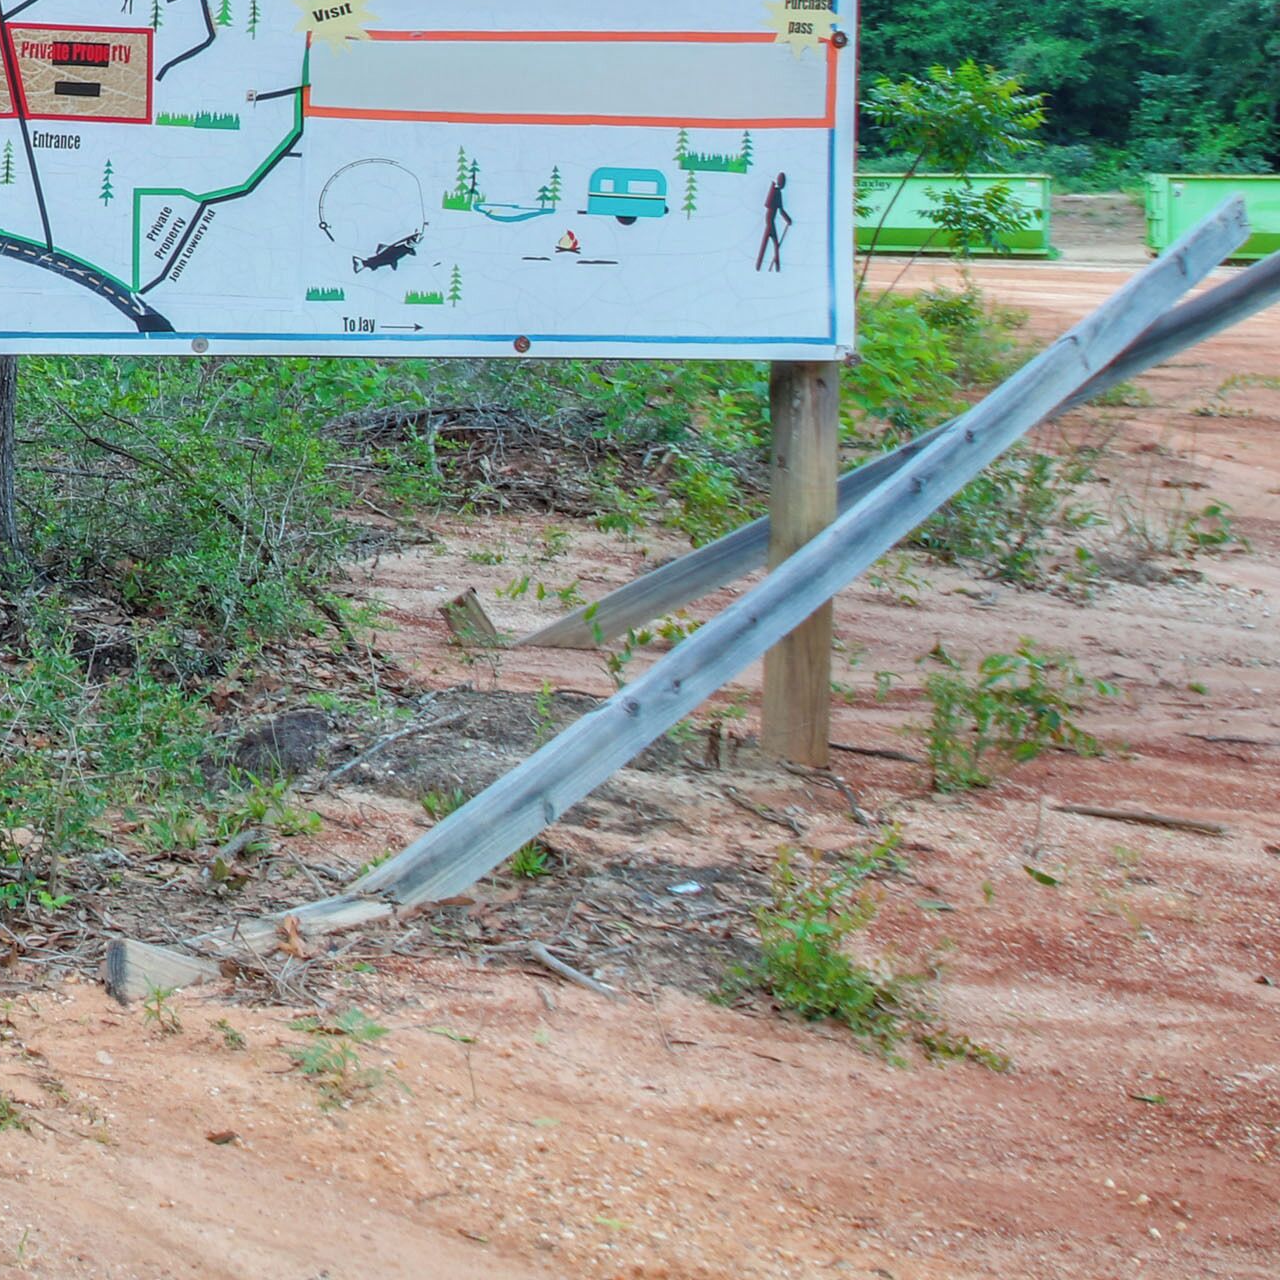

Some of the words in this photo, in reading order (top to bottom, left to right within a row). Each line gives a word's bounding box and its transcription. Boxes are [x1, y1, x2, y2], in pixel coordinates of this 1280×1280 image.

[788, 21, 814, 35] pass
[21, 41, 70, 60] Private
[72, 43, 132, 63] Property
[33, 130, 81, 149] Entrance
[146, 205, 173, 242] Private
[154, 217, 187, 260] Property
[168, 258, 188, 282] John
[182, 222, 208, 259] Lowery
[205, 208, 216, 225] Rd
[343, 317, 356, 332] To
[358, 316, 376, 333] Jay
